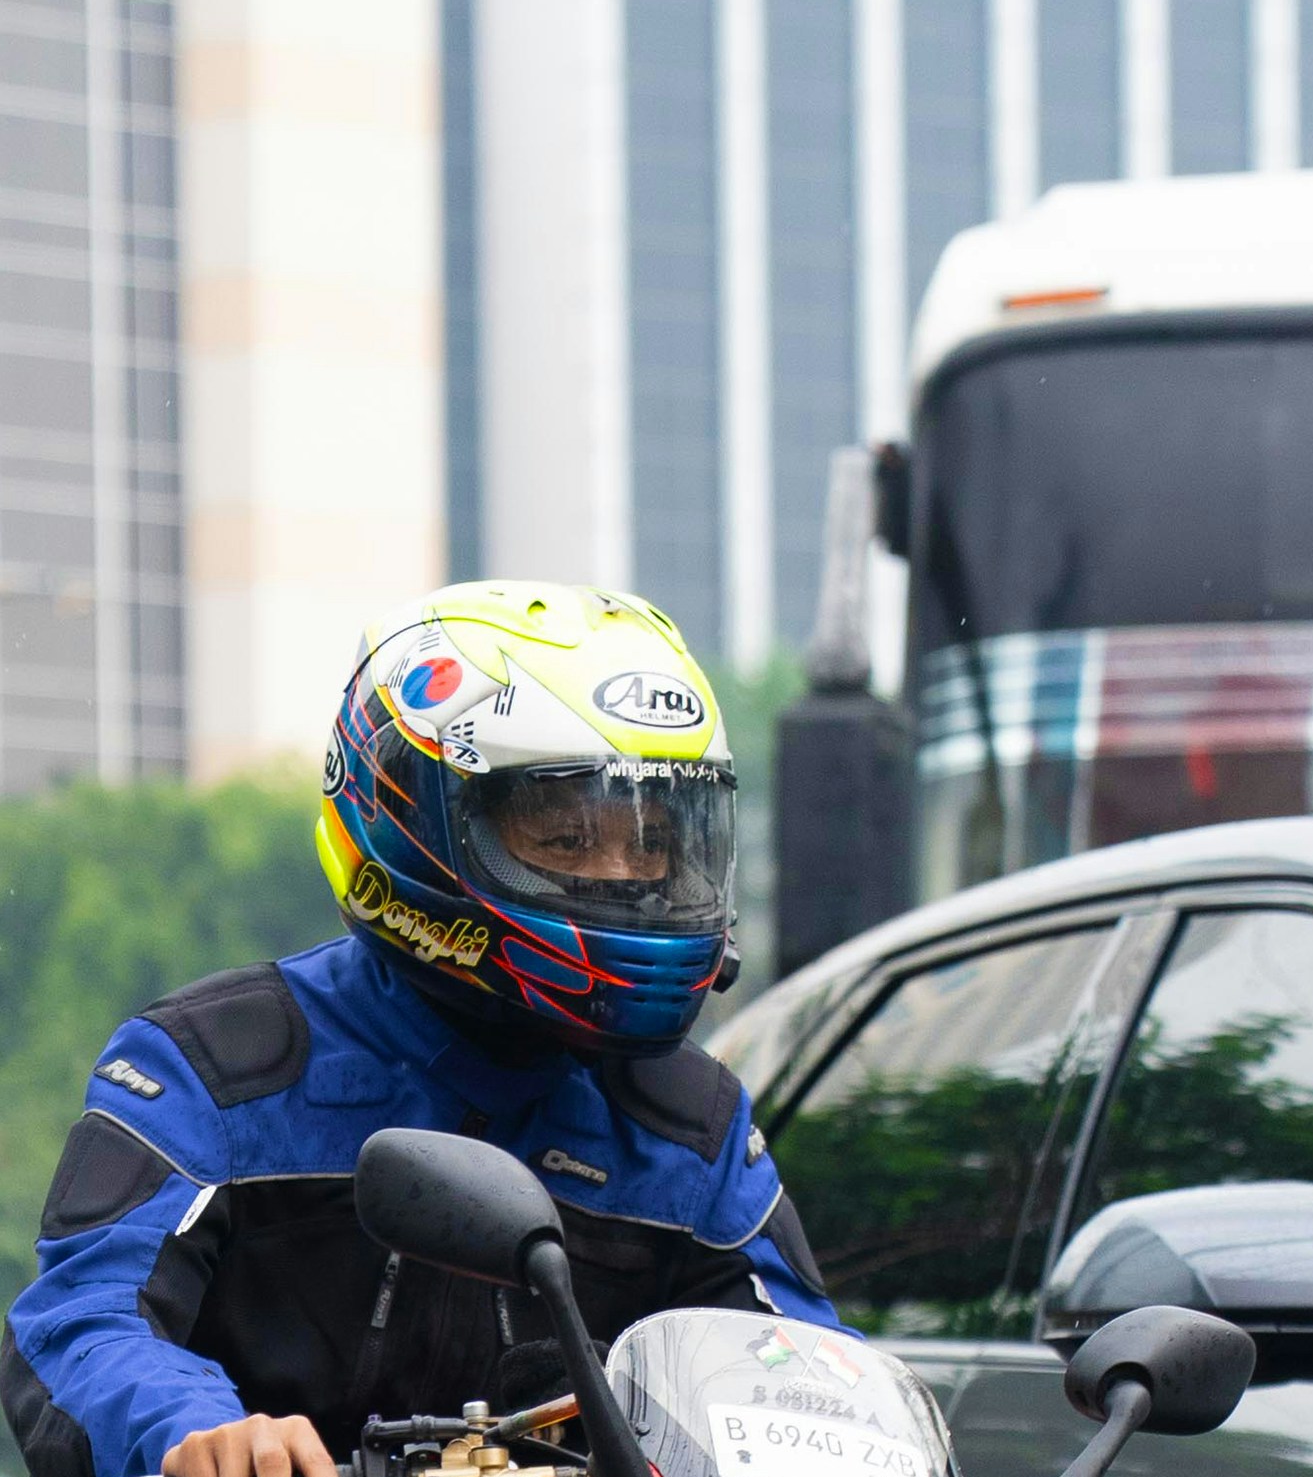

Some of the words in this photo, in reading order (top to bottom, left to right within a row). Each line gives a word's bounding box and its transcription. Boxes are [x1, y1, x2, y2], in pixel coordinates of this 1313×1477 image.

[605, 676, 696, 715] Arai
[640, 712, 682, 722] HELMET
[725, 1417, 747, 1441] B
[765, 1422, 843, 1457] 6940
